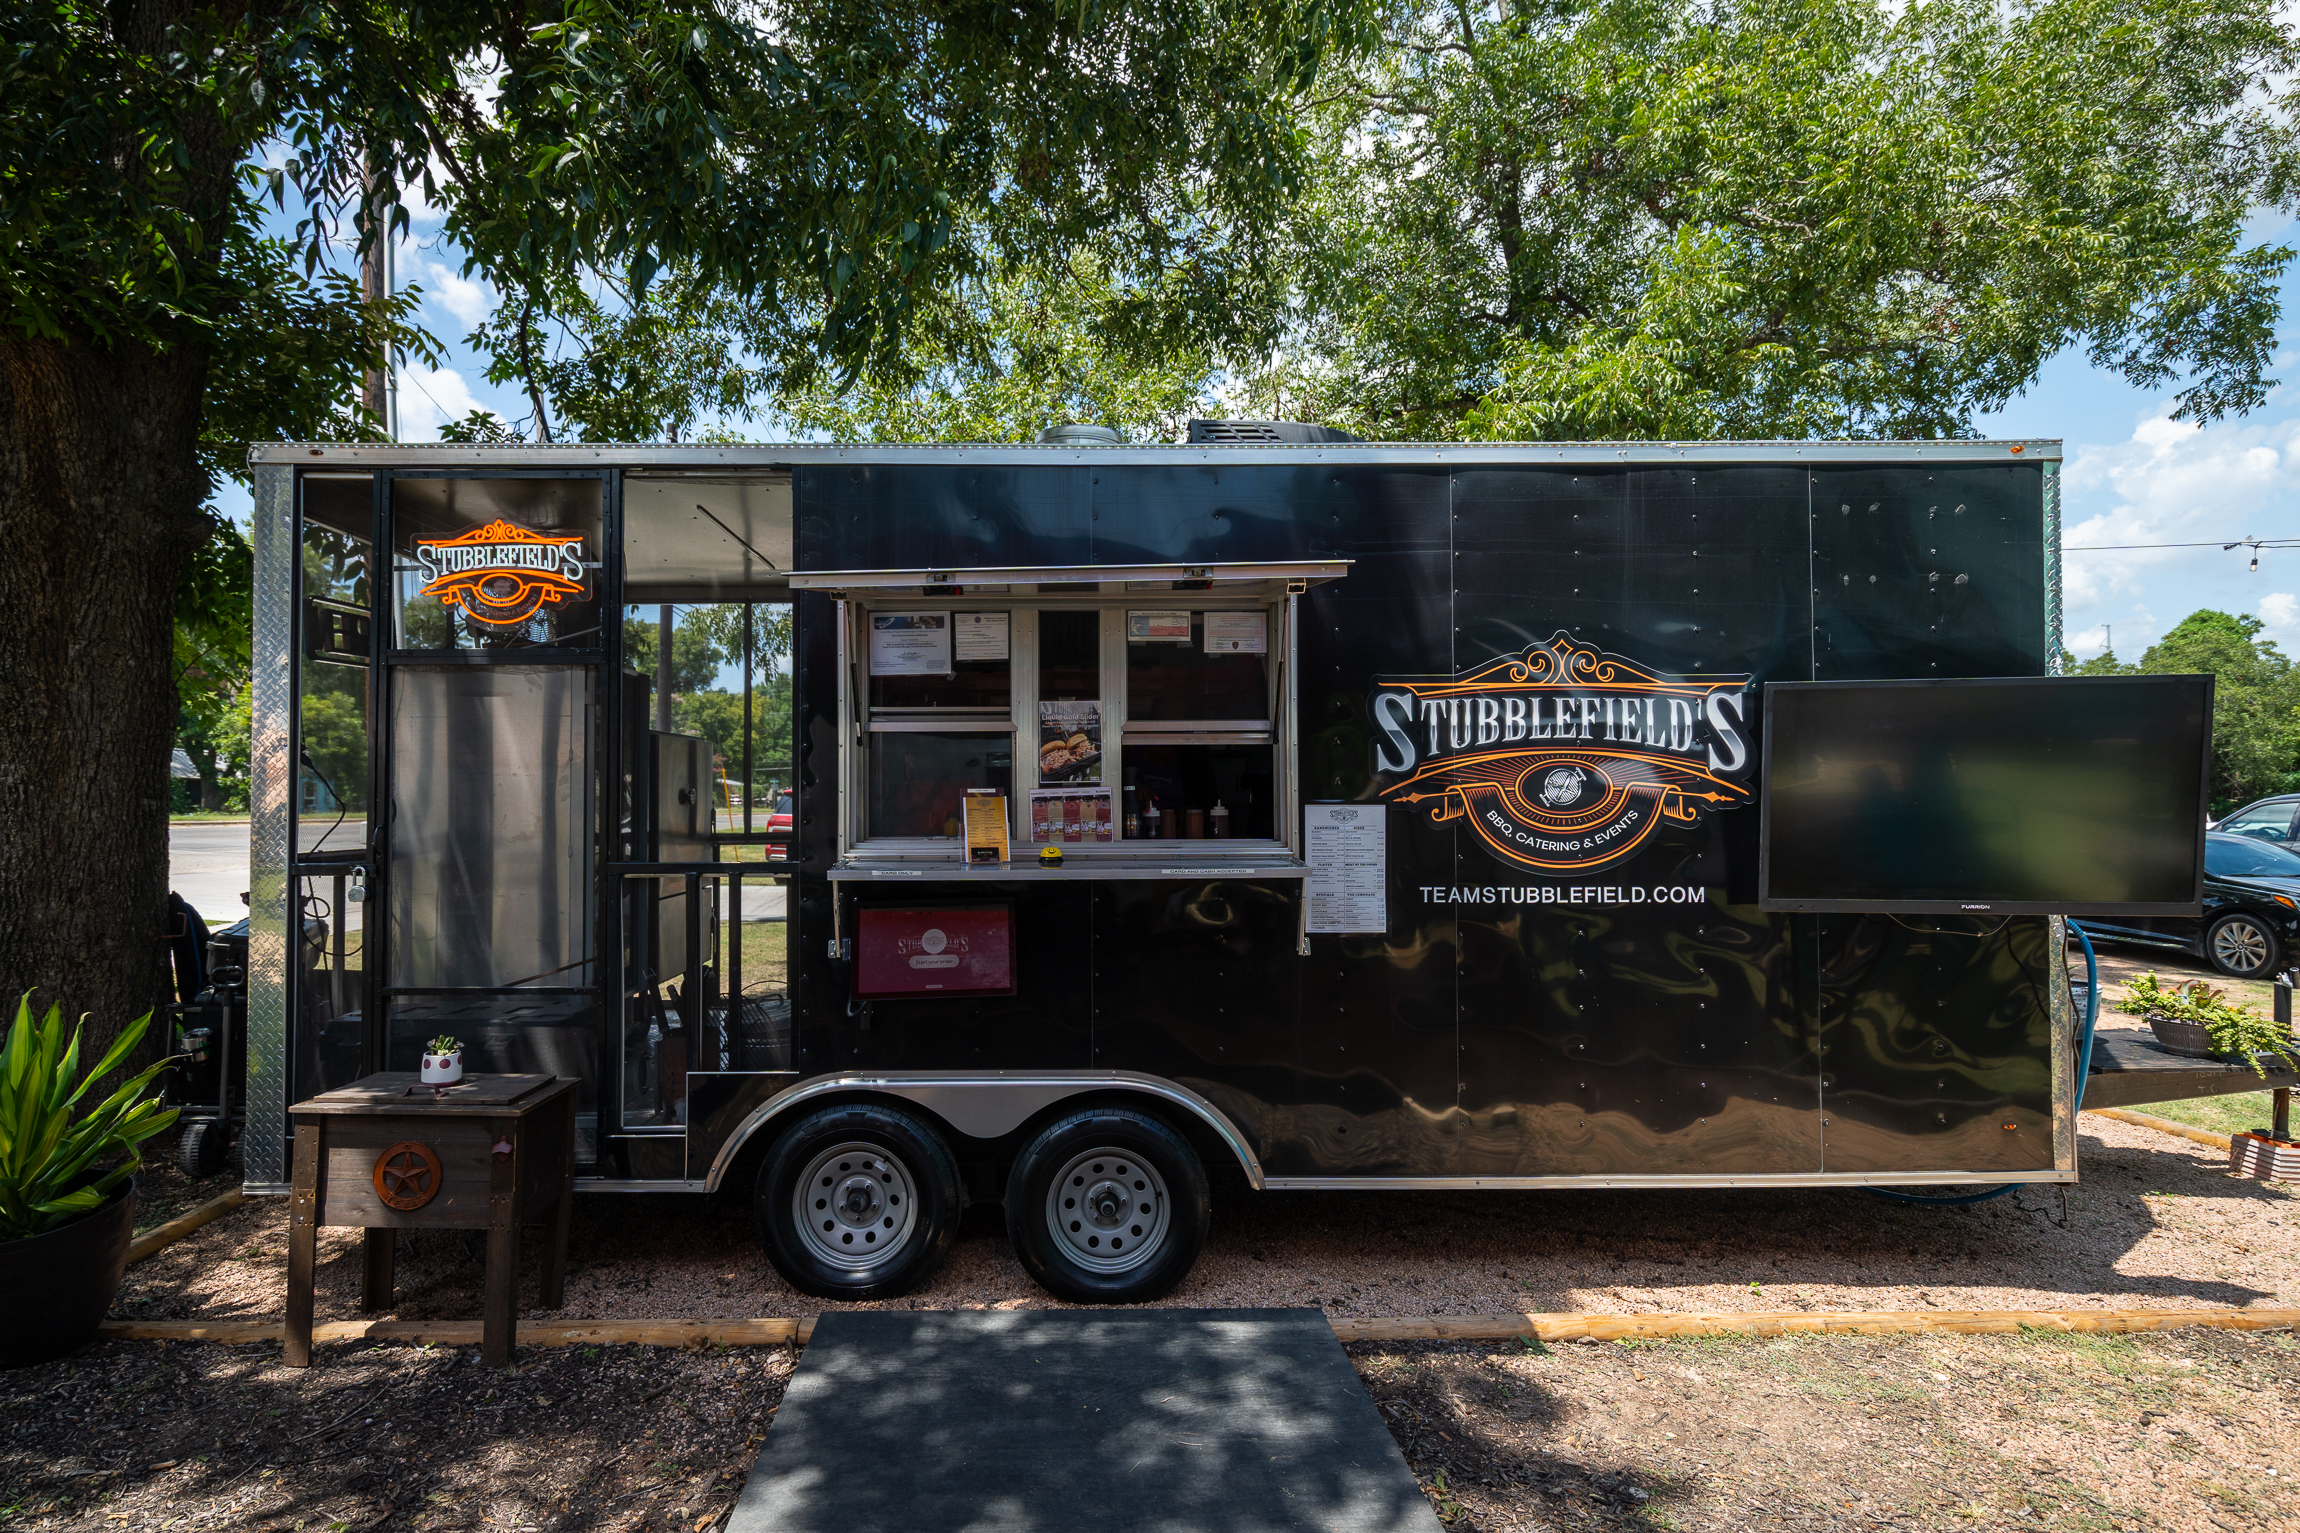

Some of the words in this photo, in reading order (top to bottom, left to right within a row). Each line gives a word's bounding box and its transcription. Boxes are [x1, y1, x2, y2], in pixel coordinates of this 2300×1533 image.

[416, 541, 584, 584] STUBBLEFIELD'S
[1376, 691, 1745, 773] STUBBLEFIELD'S
[1486, 809, 1513, 838] BBQ,
[1515, 832, 1581, 851] CATERING
[1583, 838, 1594, 848] &
[1595, 809, 1639, 845] EVENTS
[1419, 886, 1706, 904] TEAMSTUBBLEFIELD.COM
[386, 1193, 428, 1209] TEXAS
